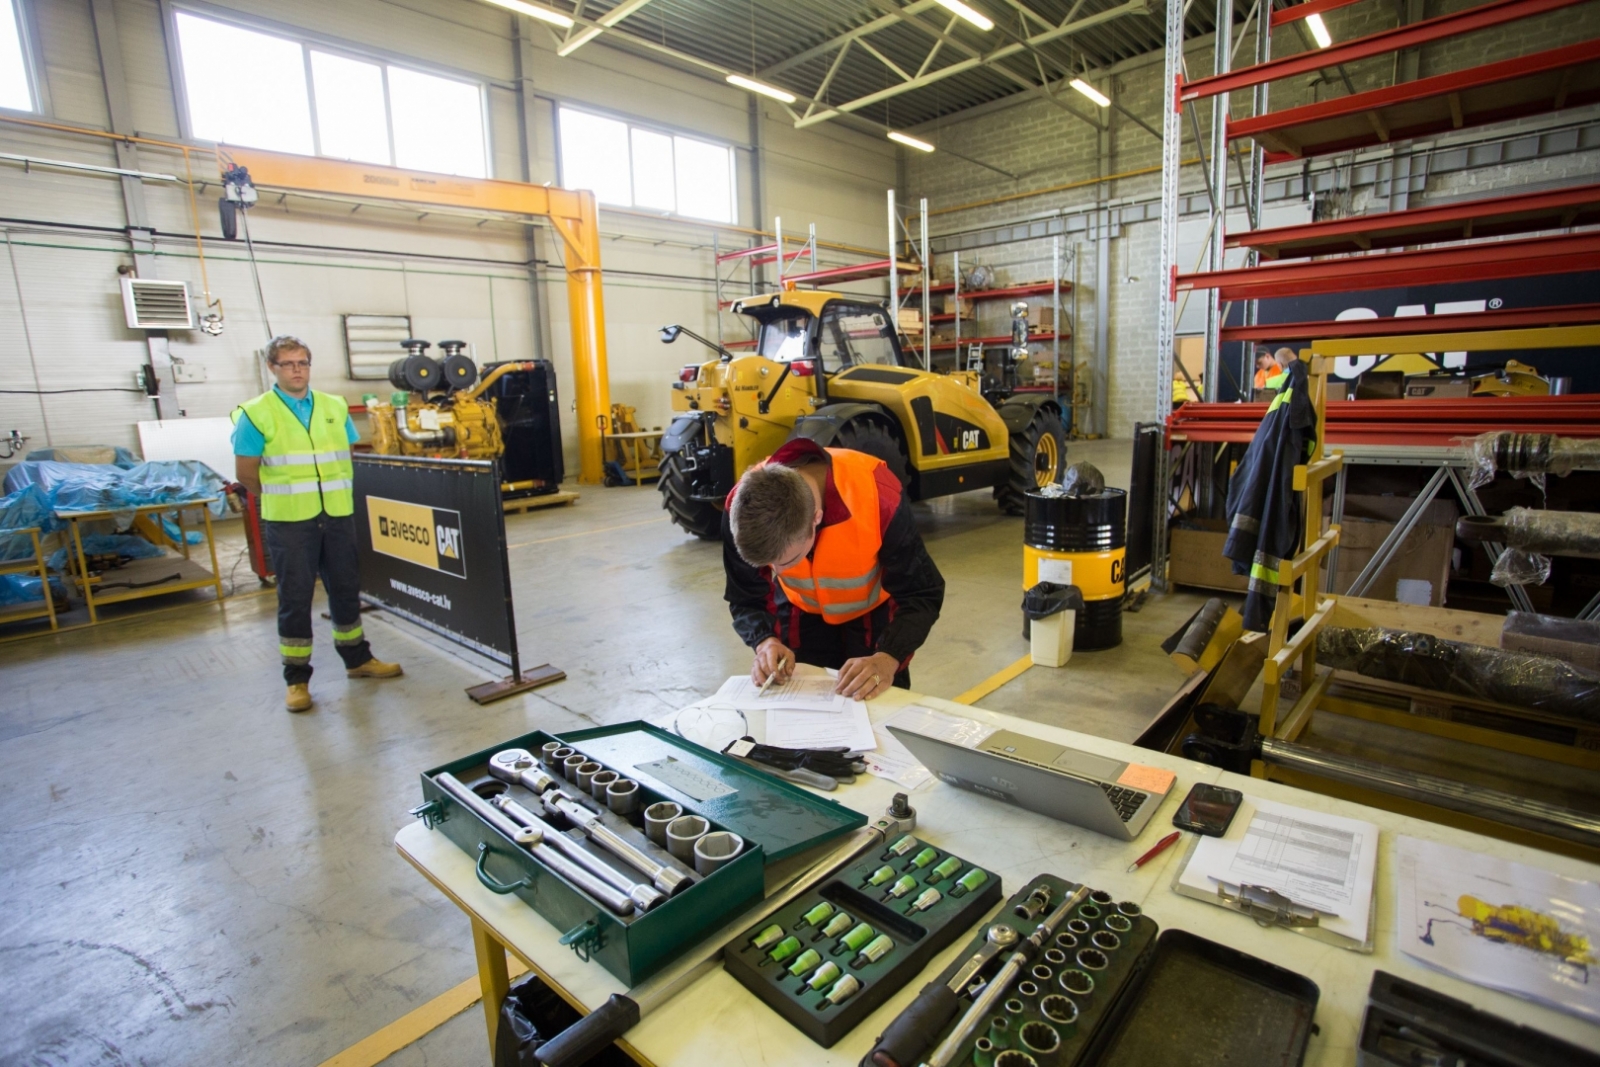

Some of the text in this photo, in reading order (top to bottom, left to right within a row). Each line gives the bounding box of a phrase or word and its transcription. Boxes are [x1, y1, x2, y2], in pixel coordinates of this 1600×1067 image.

[1411, 387, 1425, 396] CAT
[962, 430, 980, 450] CAT
[390, 519, 460, 560] avesco CAT
[390, 578, 452, 611] www.avesco-cat.lv
